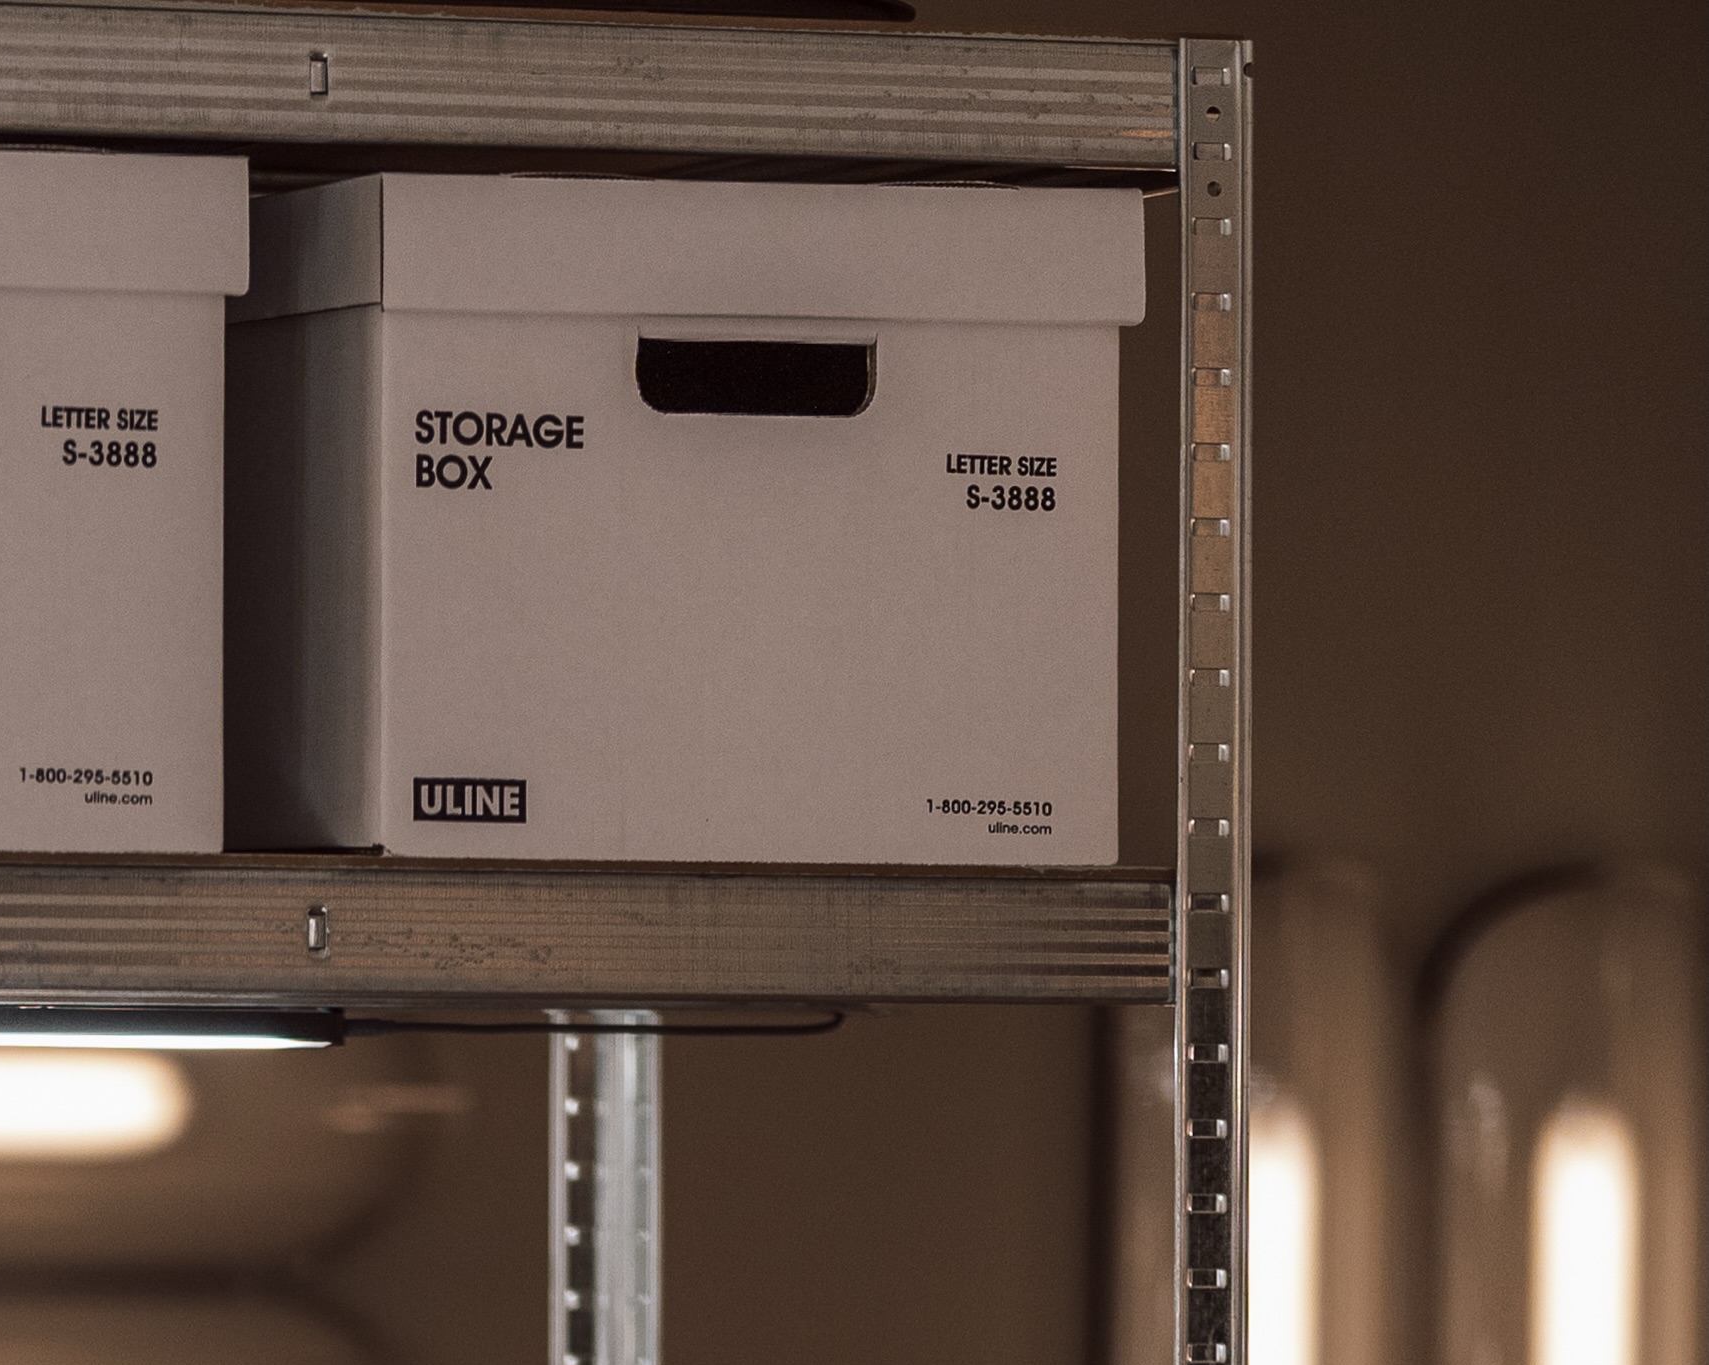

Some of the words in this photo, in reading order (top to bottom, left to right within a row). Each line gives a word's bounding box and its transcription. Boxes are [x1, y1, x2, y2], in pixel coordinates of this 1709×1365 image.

[41, 406, 110, 429] LETTER
[117, 408, 158, 431] SIZE
[415, 410, 584, 449] STORAGE
[63, 439, 157, 468] S-3888
[947, 454, 1012, 475] LETTER
[1018, 456, 1056, 477] SIZE
[416, 454, 492, 489] BOX
[967, 485, 1055, 511] S-3888
[20, 768, 153, 786] 1-800-295-5510
[85, 791, 152, 805] uline.com
[420, 785, 519, 816] ULINE
[927, 799, 1052, 816] 1-800-295-5510
[988, 822, 1052, 834] uline.com
